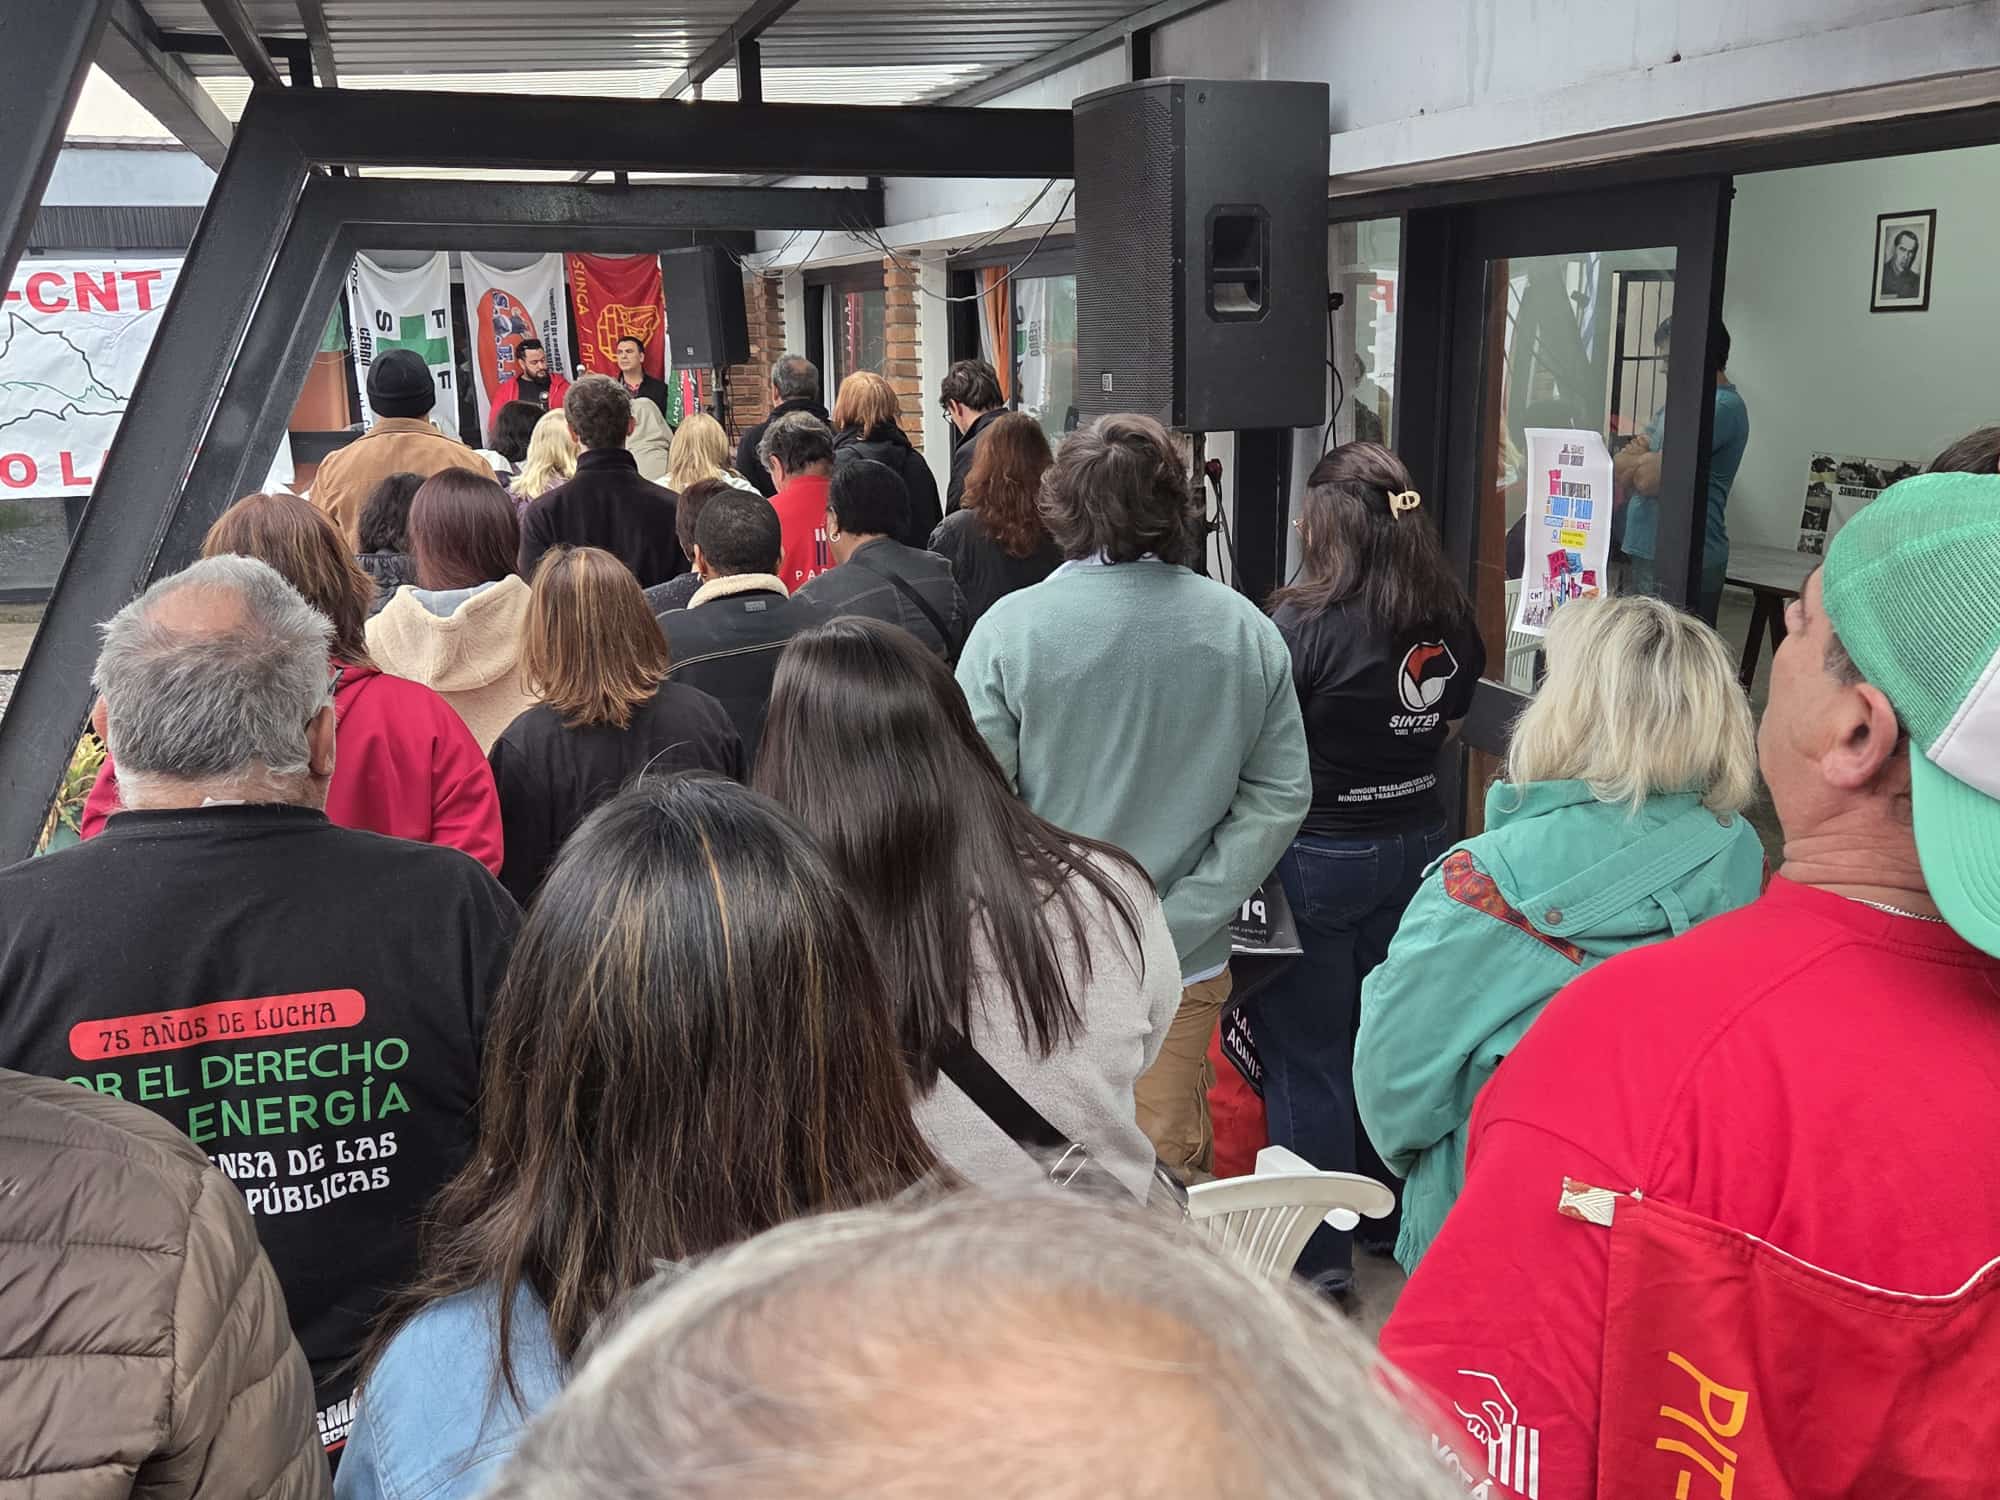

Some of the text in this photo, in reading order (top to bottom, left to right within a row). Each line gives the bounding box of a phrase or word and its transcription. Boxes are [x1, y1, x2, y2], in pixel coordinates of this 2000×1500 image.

[572, 259, 590, 315] SUNCA
[1389, 713, 1440, 728] SINTEP
[99, 1002, 337, 1053] 75 AÑOS DE LUCHA
[138, 1064, 190, 1101] EL
[200, 1037, 410, 1090] DERECHO
[188, 1076, 411, 1144] ENERGÍA
[288, 1144, 325, 1176] DE
[337, 1131, 398, 1166] LAS
[246, 1166, 390, 1216] PÚBLICAS
